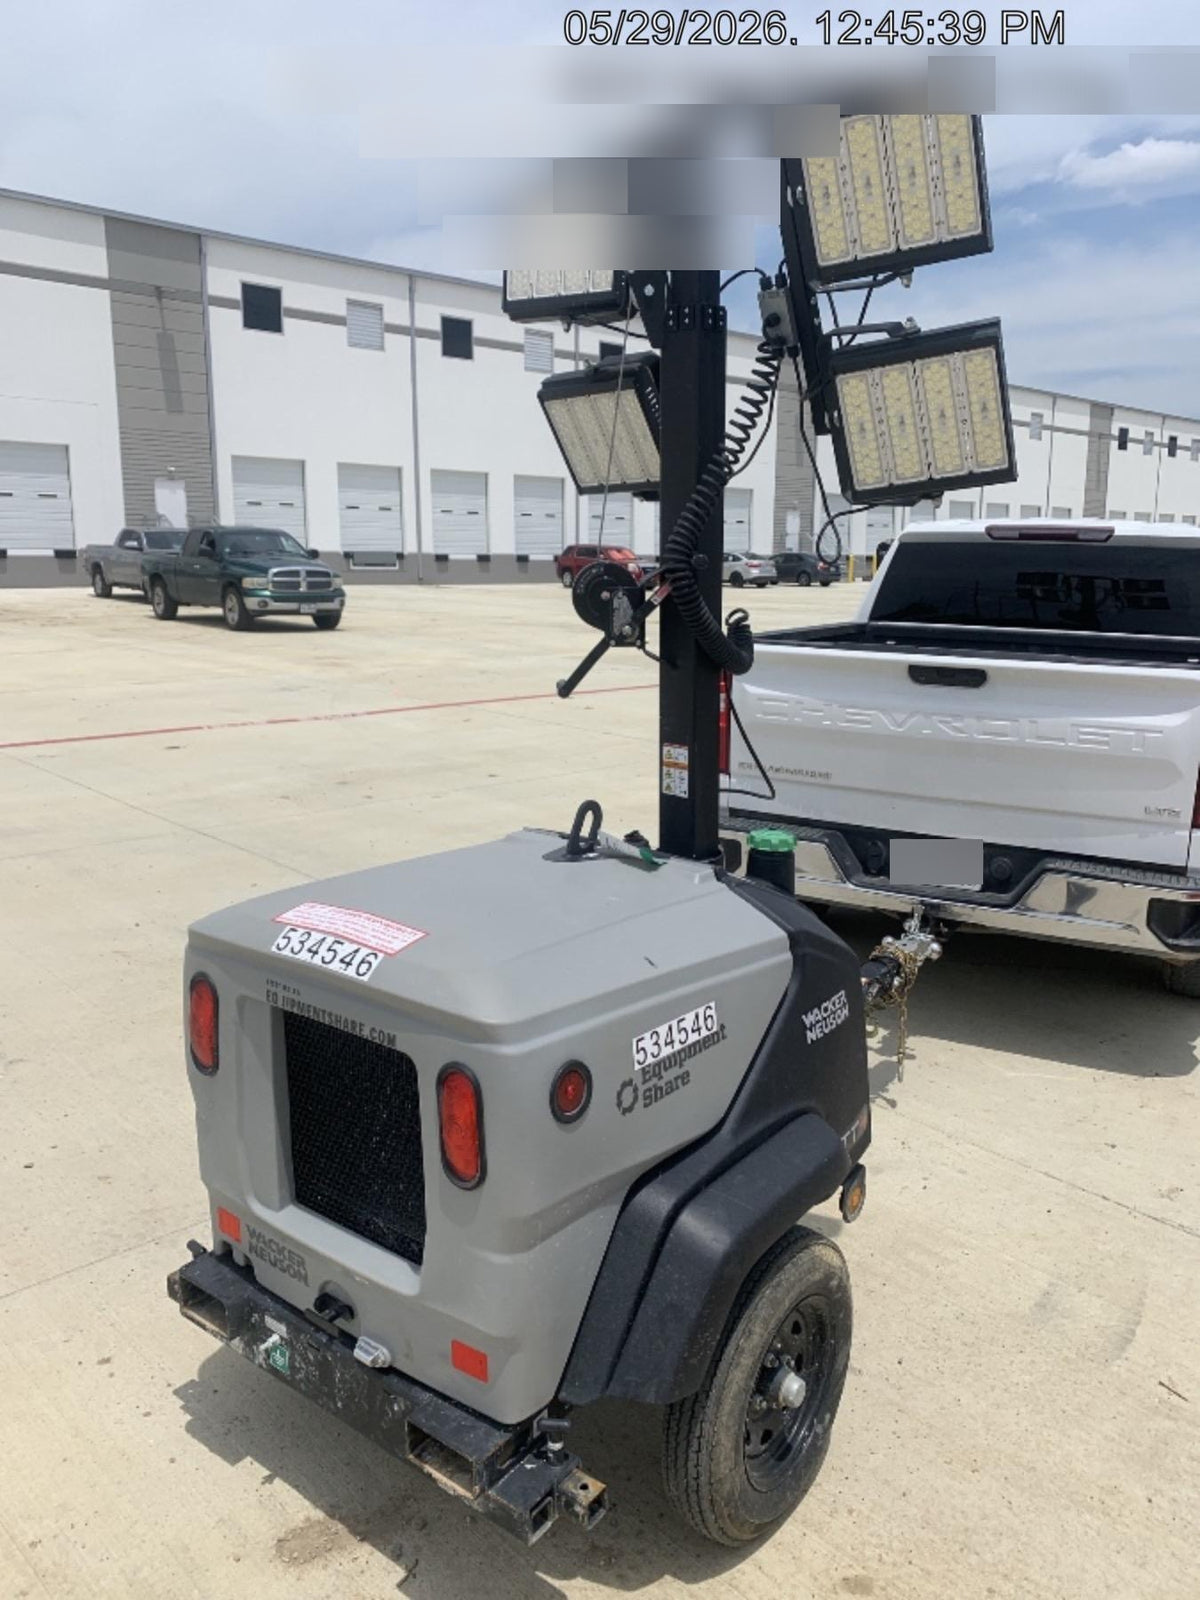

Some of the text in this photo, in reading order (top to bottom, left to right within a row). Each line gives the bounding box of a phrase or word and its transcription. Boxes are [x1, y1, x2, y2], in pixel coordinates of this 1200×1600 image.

[756, 697, 1166, 752] CHEVROLET
[276, 929, 378, 977] 534546
[802, 989, 847, 1027] WACKER
[806, 1006, 848, 1044] NEUSON
[635, 1004, 716, 1067] 534546
[642, 1024, 727, 1085] Equipment
[643, 1069, 690, 1108] Share
[247, 1226, 306, 1269] WACKER
[249, 1244, 309, 1287] NEUSON
